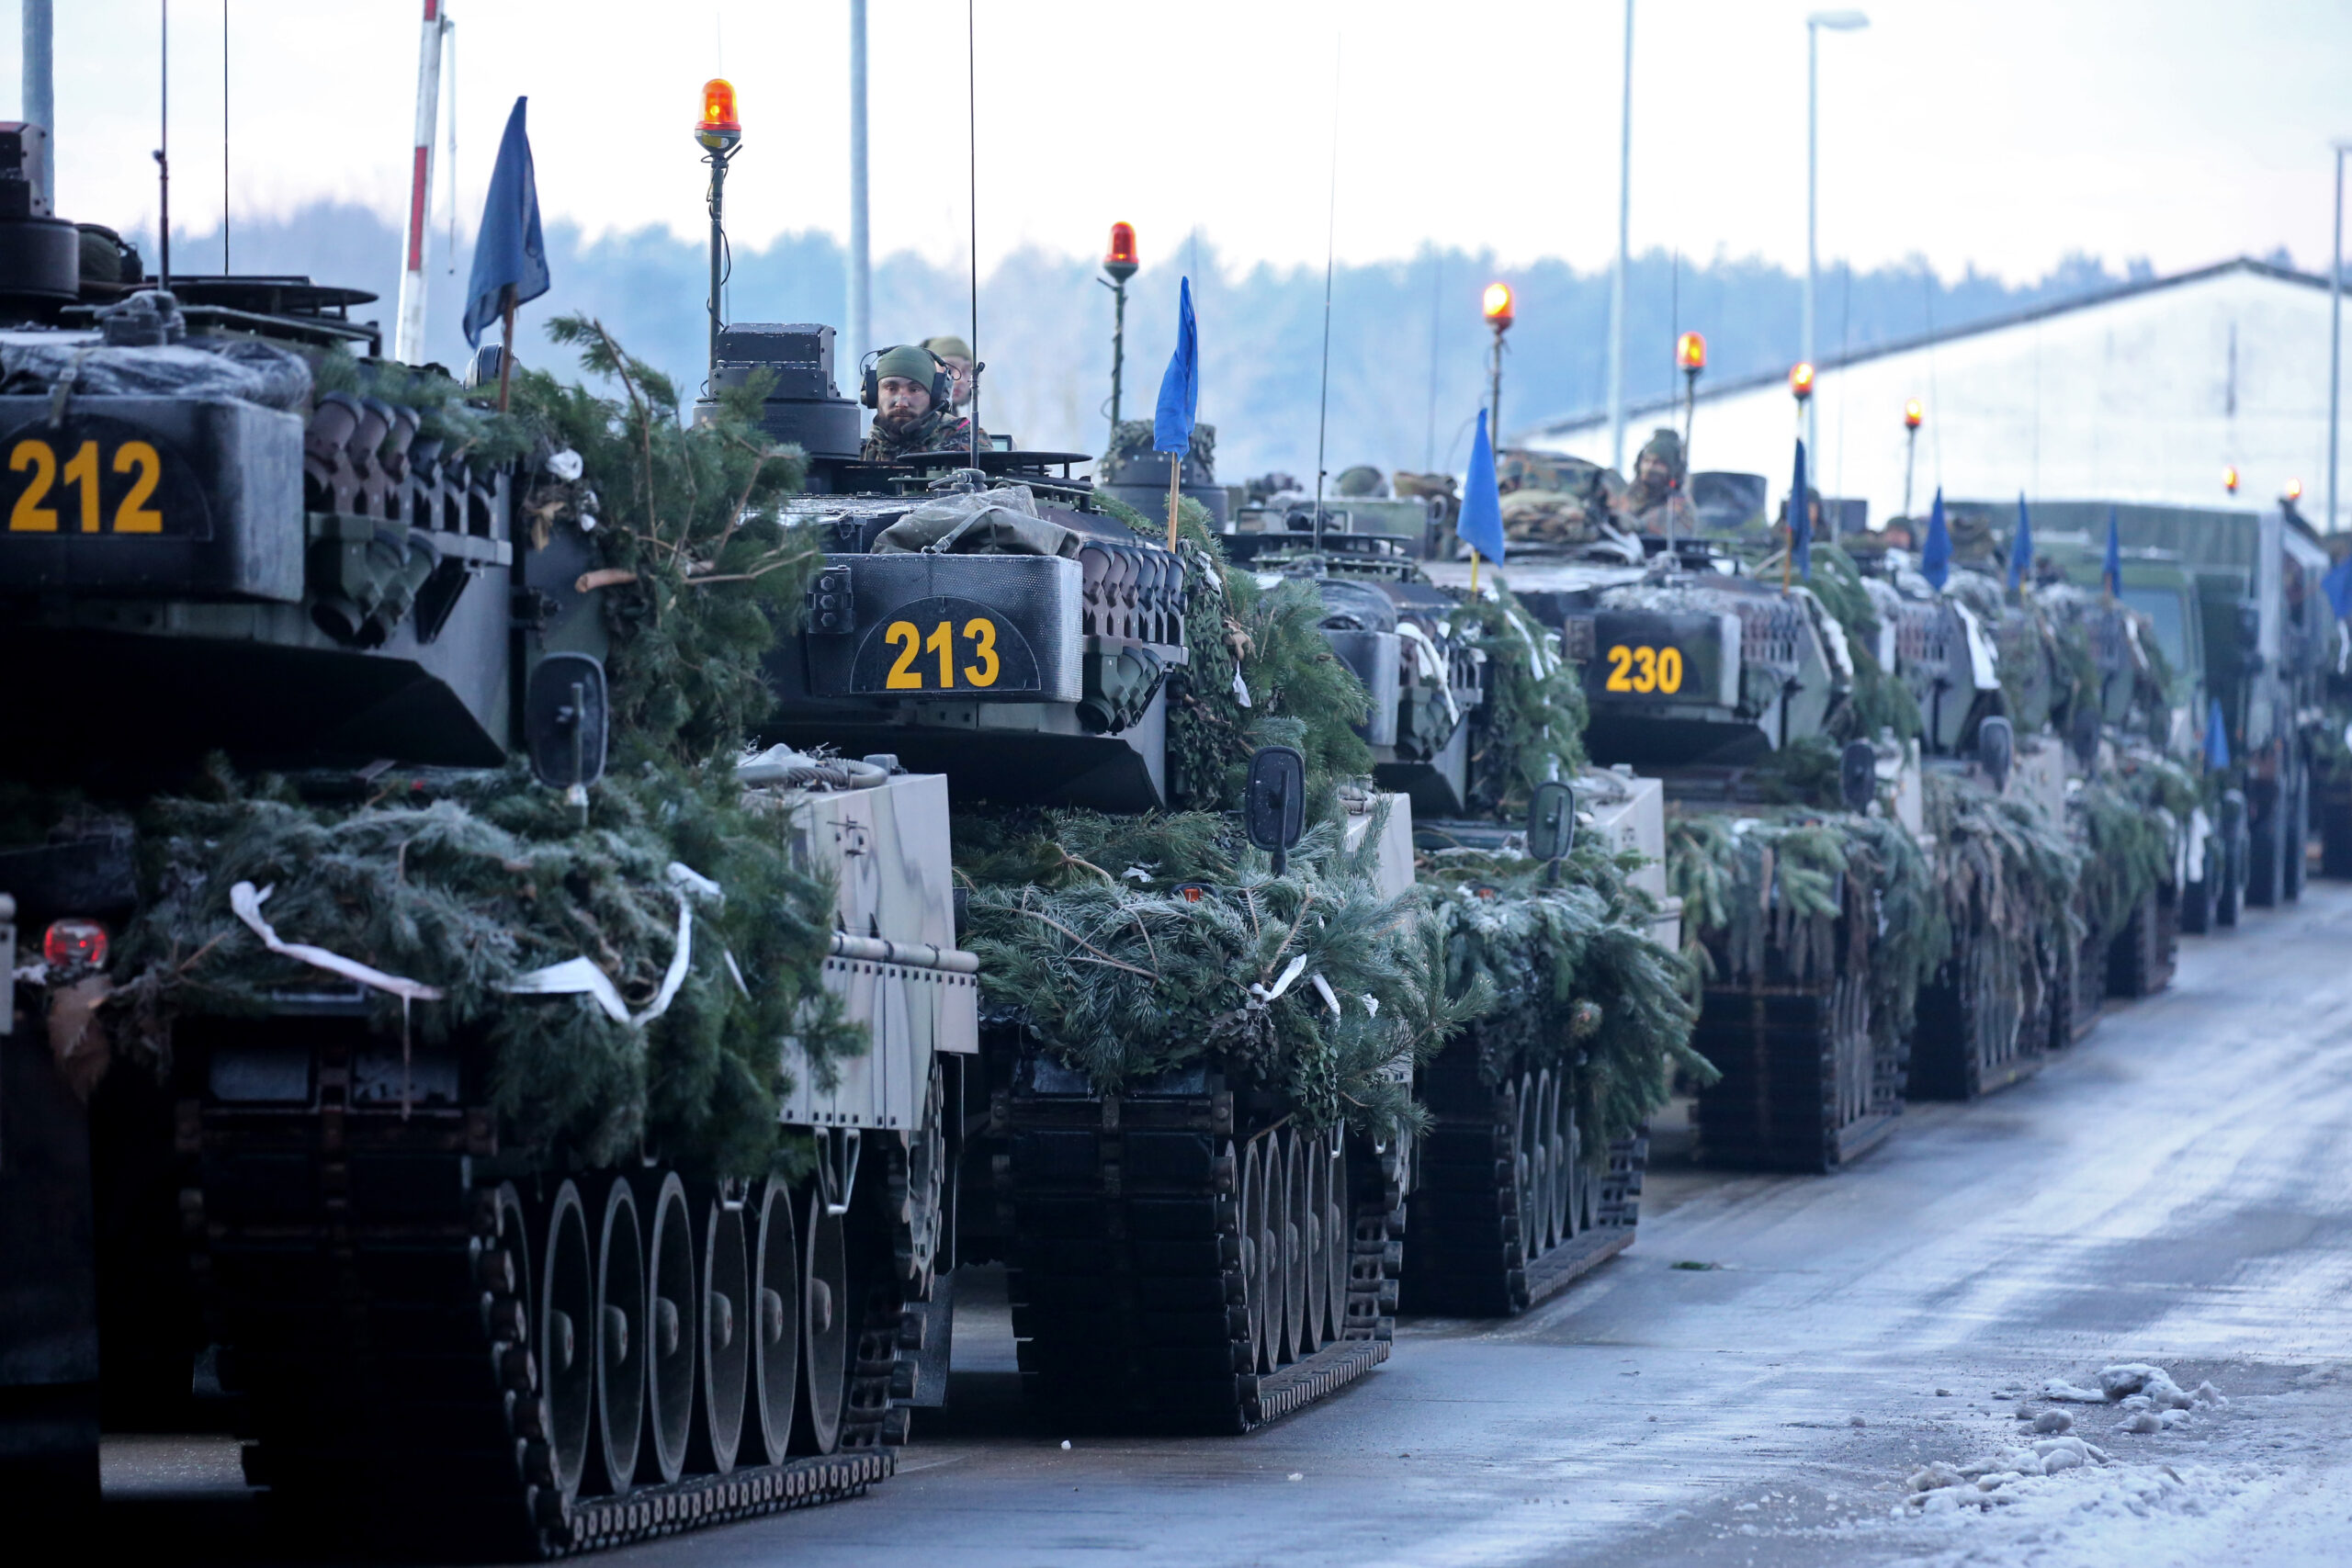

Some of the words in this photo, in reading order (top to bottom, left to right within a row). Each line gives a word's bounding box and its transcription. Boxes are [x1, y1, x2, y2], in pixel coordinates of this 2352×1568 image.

[9, 439, 163, 533] 212
[885, 617, 1000, 689] 213
[1606, 645, 1683, 694] 230
